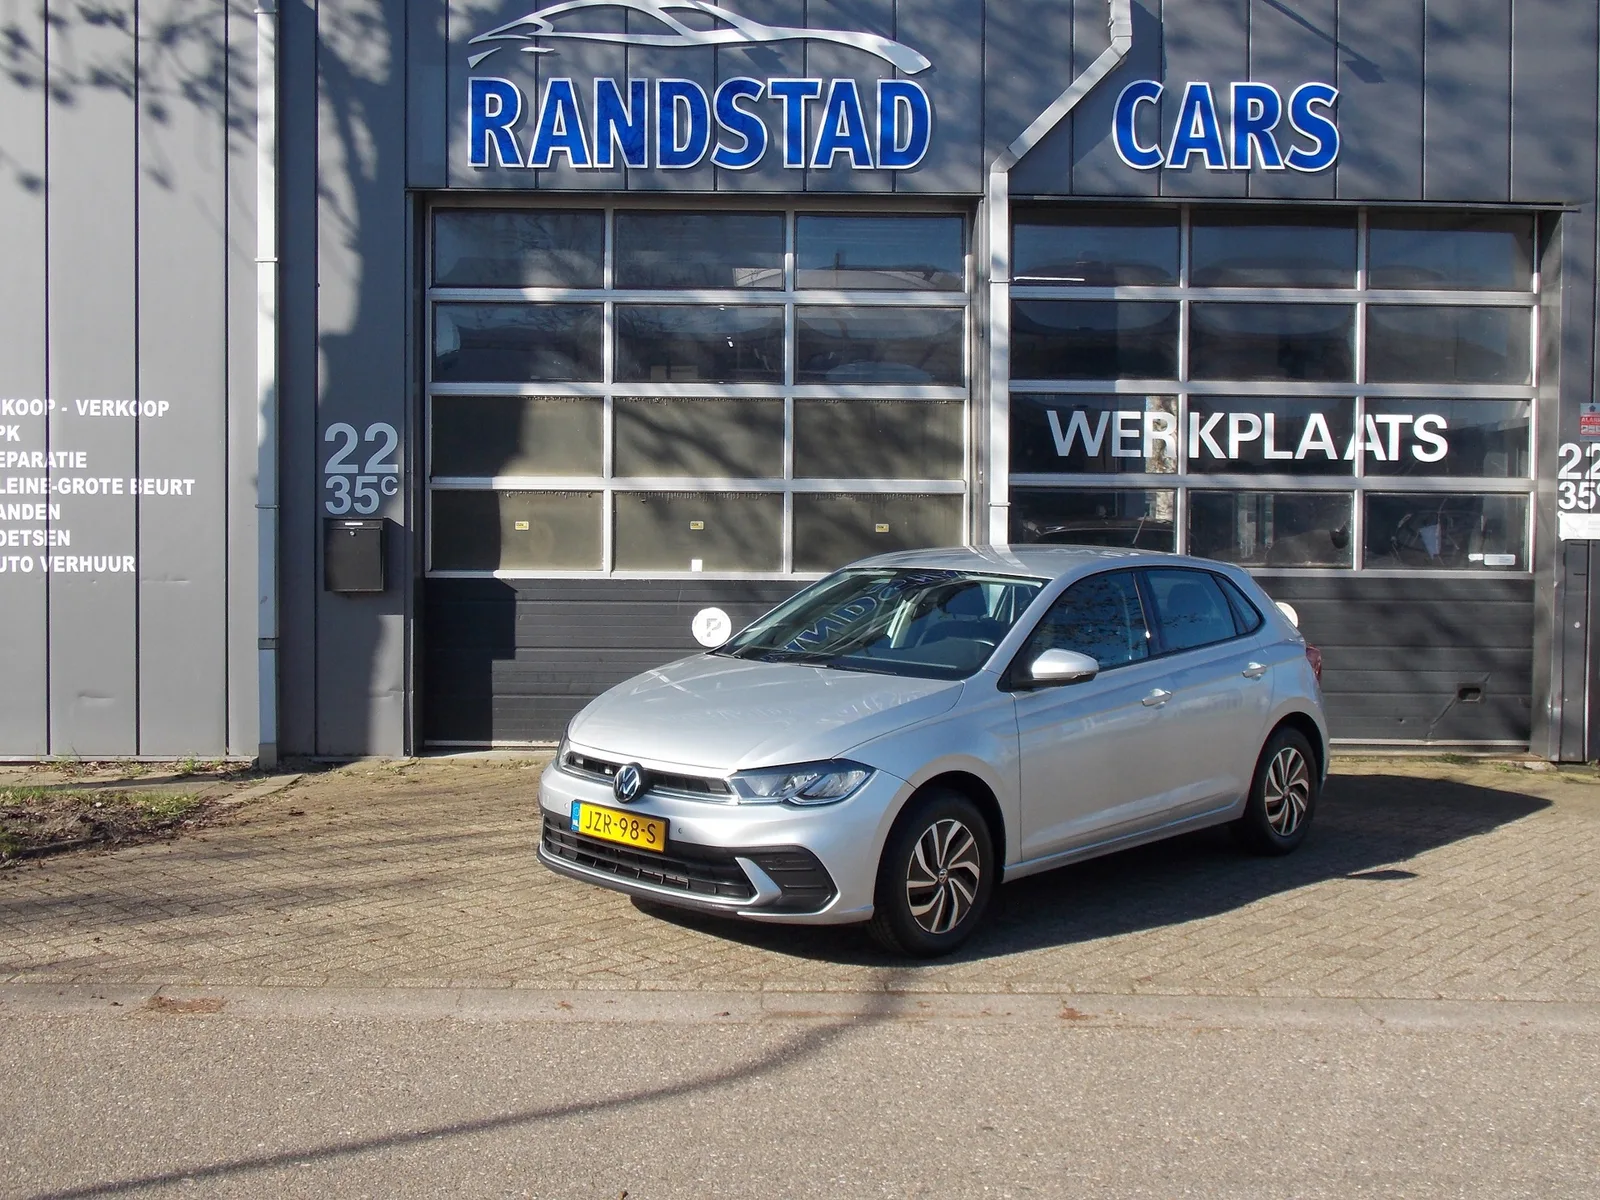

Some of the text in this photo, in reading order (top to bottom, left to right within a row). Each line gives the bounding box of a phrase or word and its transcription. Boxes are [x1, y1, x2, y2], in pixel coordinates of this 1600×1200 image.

[467, 77, 1340, 173] RANDSTAD CARS
[2, 398, 56, 416] KOOP
[75, 399, 170, 417] VERKOOP
[324, 422, 399, 474] 22
[1046, 410, 1449, 463] WERKPLAATS
[1558, 442, 1600, 480] 22
[130, 478, 196, 496] BEURT
[1558, 480, 1600, 510] 35
[40, 555, 136, 573] VERHUUR
[585, 810, 657, 845] JZR-98-S
